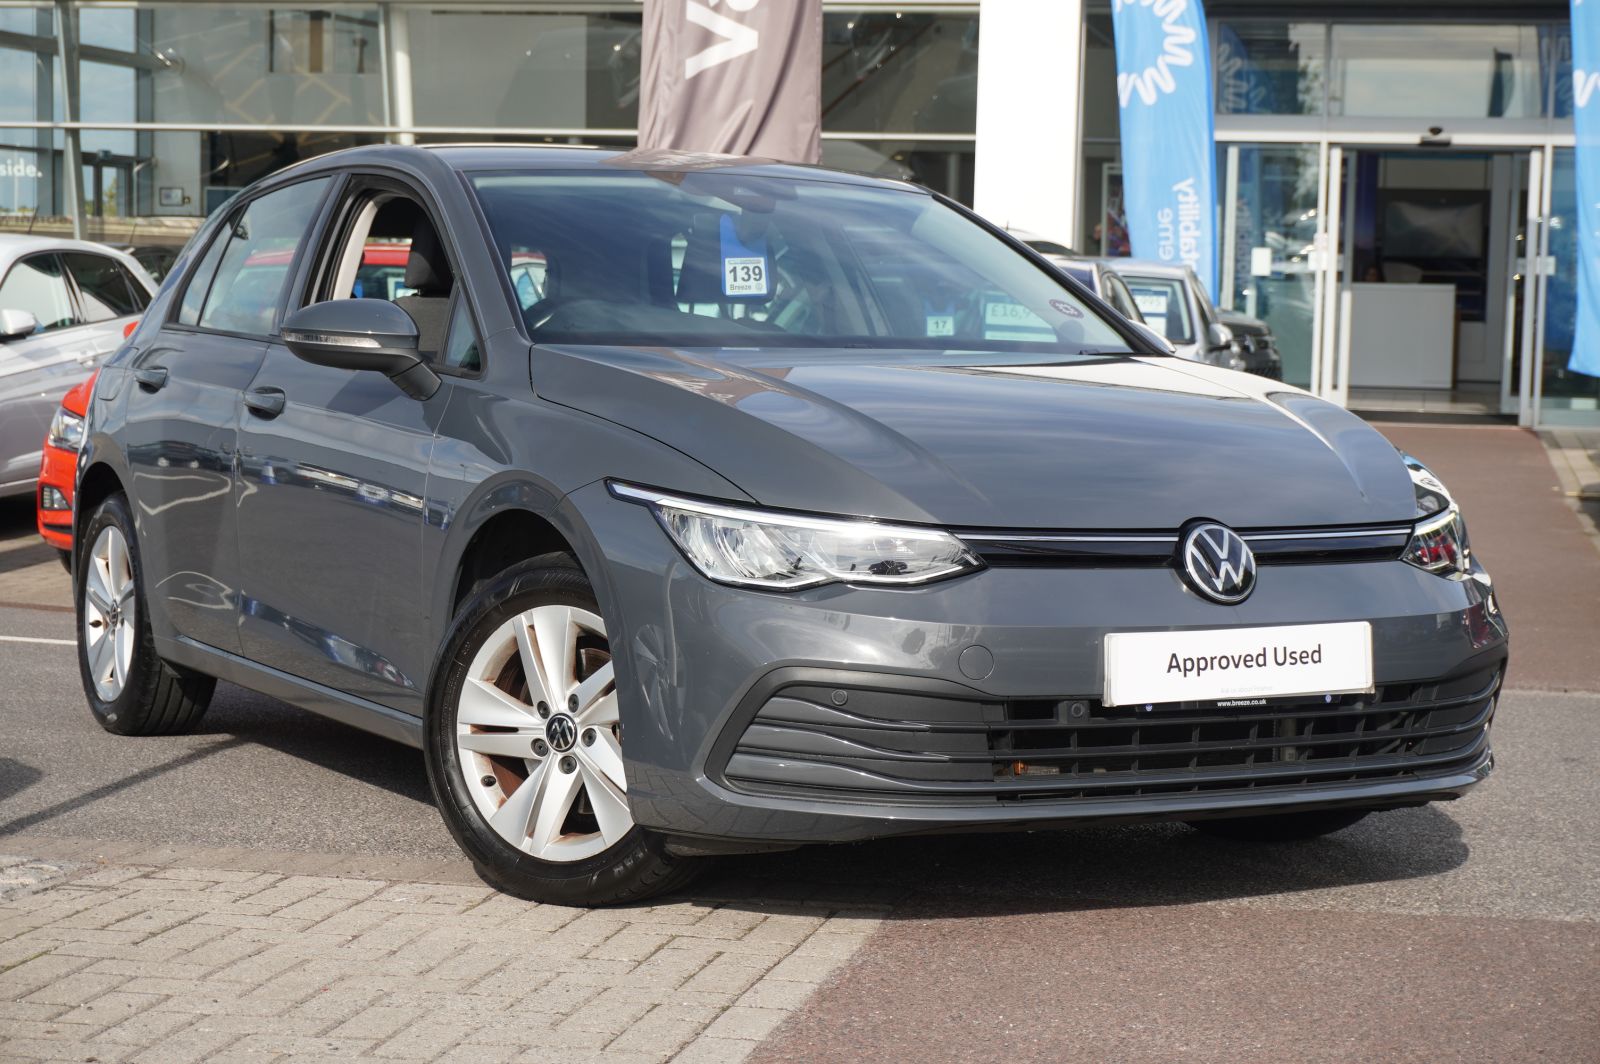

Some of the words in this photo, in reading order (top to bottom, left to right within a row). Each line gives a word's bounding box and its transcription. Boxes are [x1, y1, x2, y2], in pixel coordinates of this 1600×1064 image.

[729, 265, 762, 282] 139
[1167, 646, 1267, 677] Approved
[1273, 643, 1322, 667] Used
[1217, 698, 1267, 707] www.breeze.co.uk
